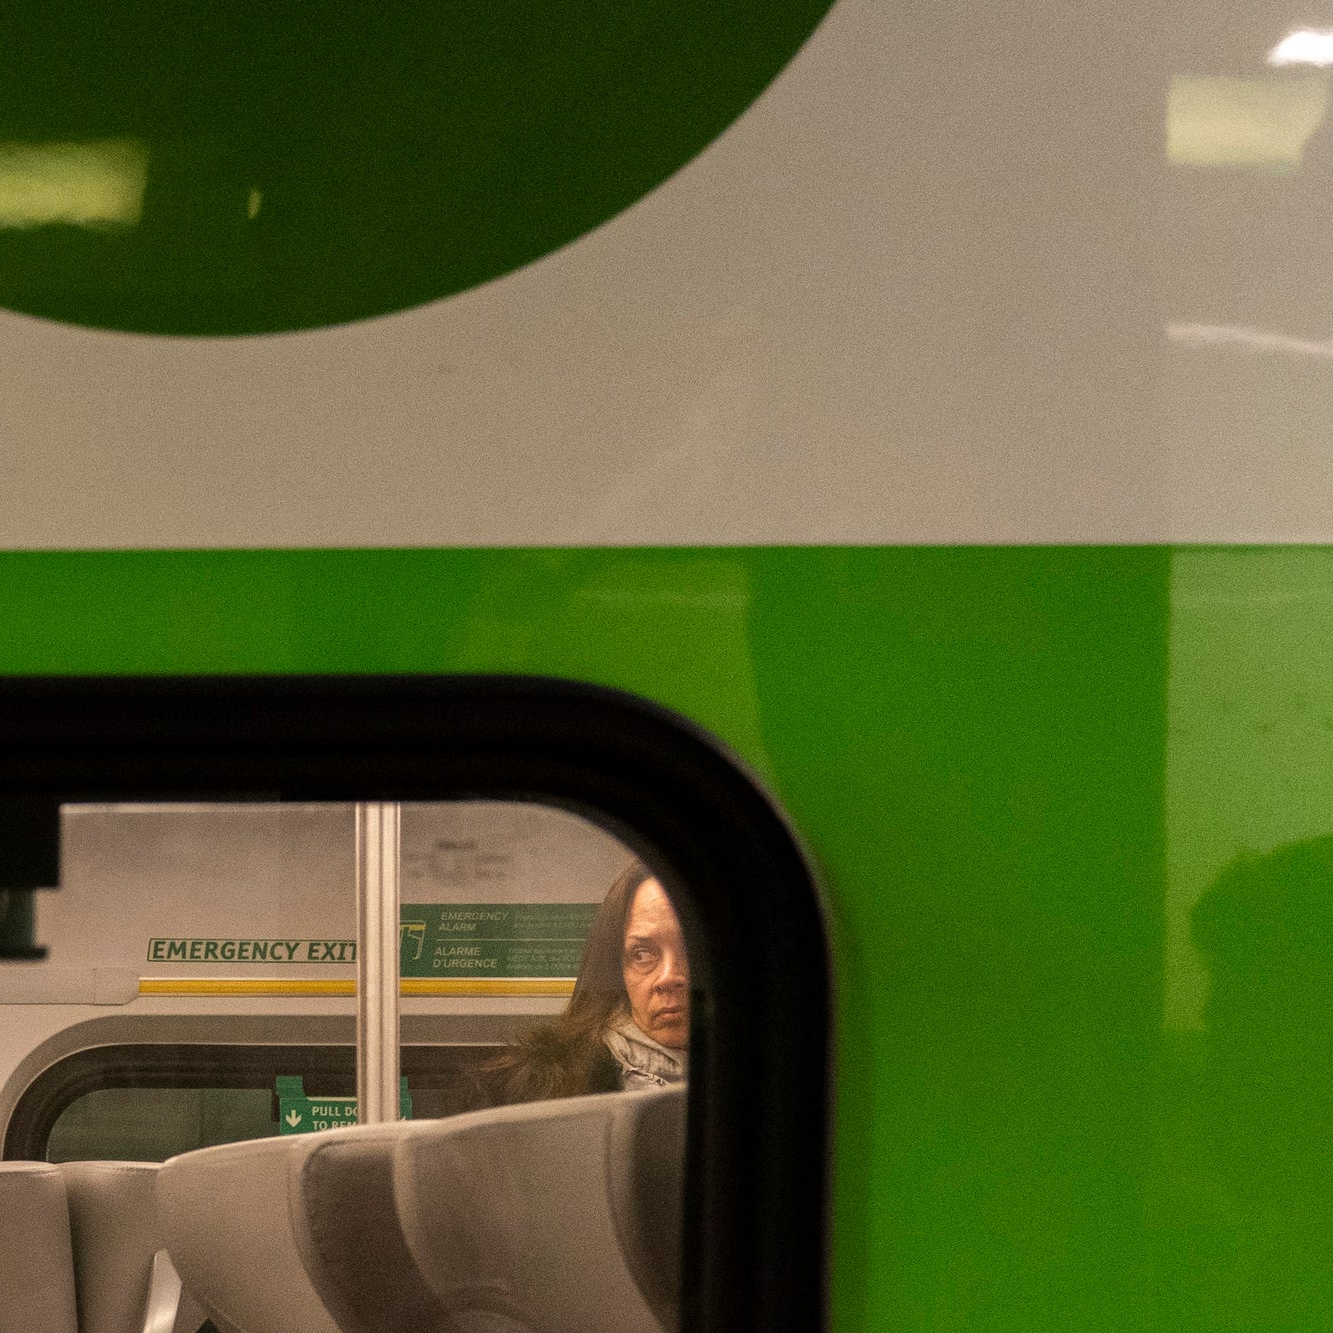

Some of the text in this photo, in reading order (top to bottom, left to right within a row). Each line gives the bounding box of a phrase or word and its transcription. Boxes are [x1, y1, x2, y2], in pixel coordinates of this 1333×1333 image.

[440, 912, 509, 921] EMERGENCY
[438, 923, 476, 932] ALARM
[152, 941, 357, 961] EMERGENCY EXIT
[433, 947, 481, 956] ALARME
[432, 959, 498, 968] D'URGENCE
[311, 1107, 357, 1116] PULL DO
[312, 1121, 328, 1130] TO
